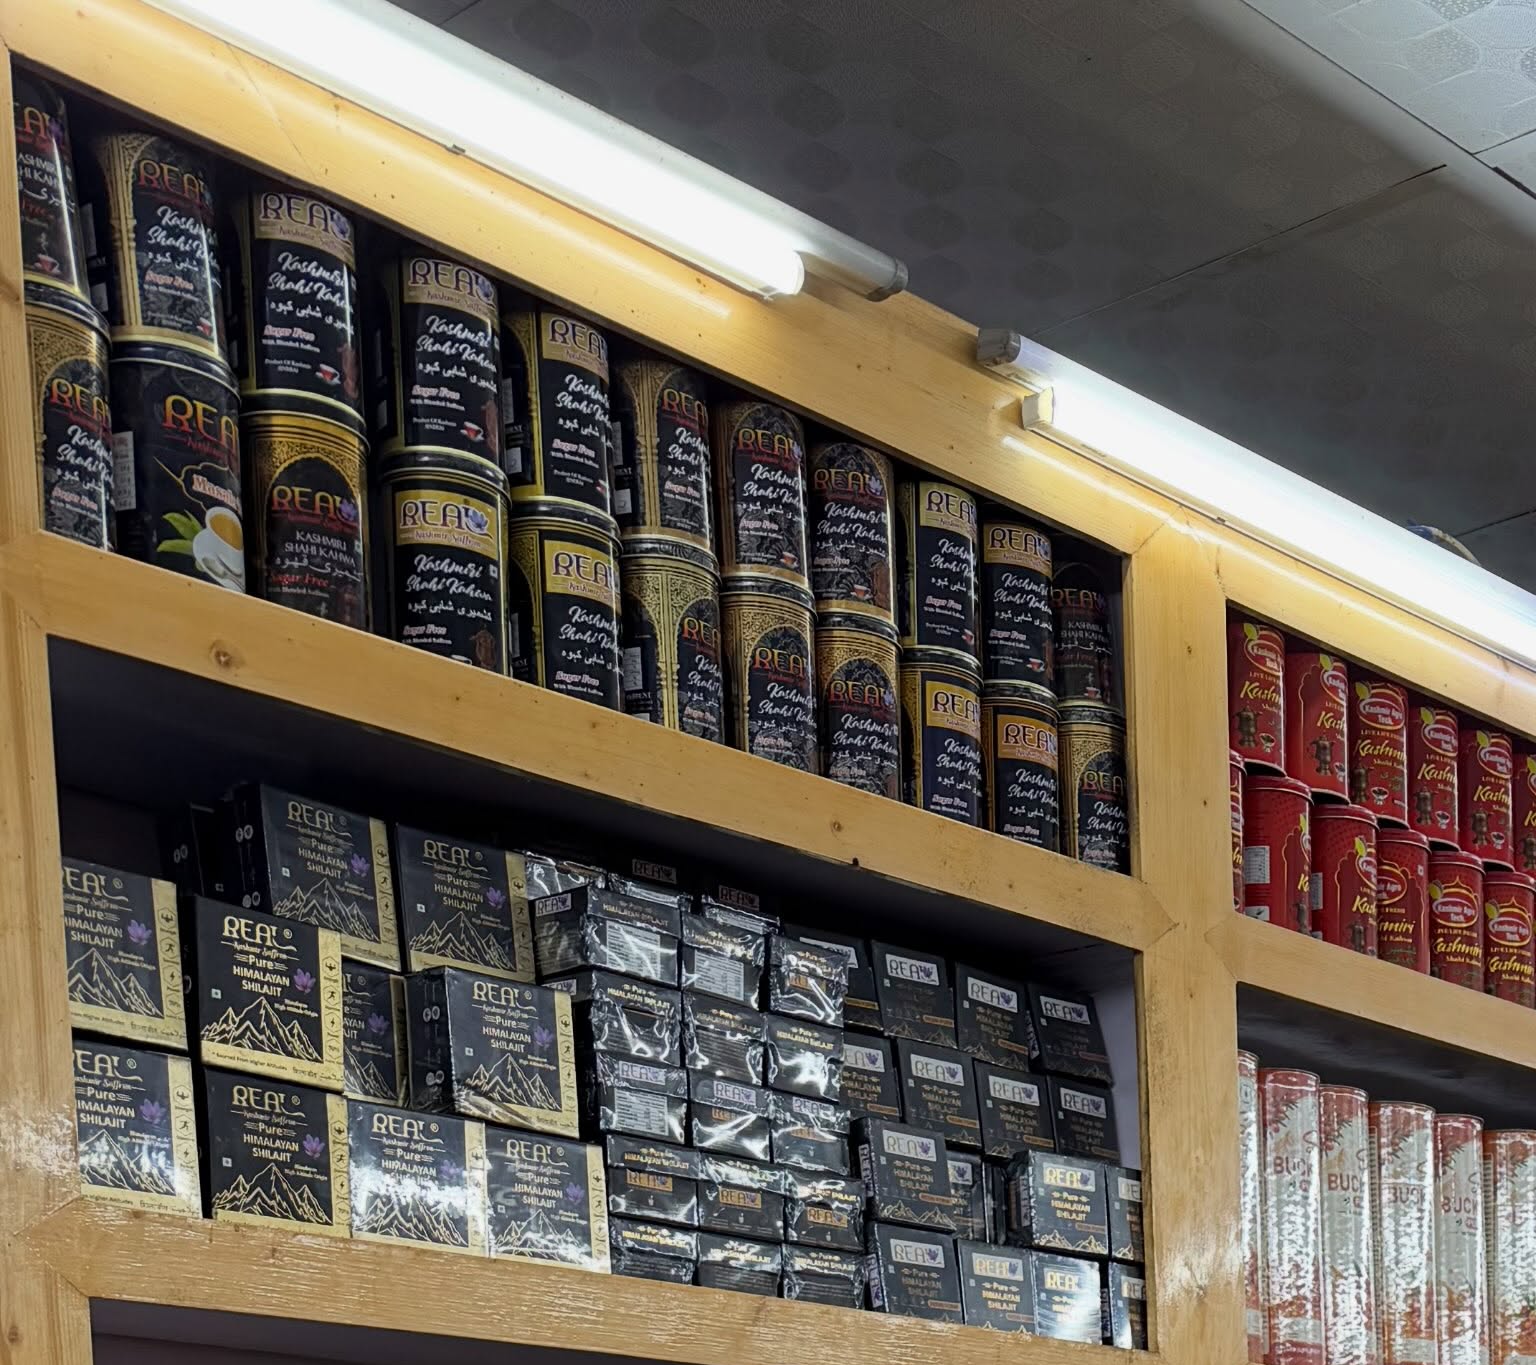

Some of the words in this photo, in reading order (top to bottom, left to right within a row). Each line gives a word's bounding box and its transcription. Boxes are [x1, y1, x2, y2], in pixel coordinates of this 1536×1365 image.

[416, 335, 459, 356] Shahi
[414, 554, 483, 578] Kashmiri
[406, 575, 445, 593] Shahi
[447, 580, 493, 601] Kahwa
[288, 801, 352, 837] REAL
[299, 847, 348, 870] HIMALAYAN
[424, 840, 488, 872] REAL
[307, 862, 342, 879] SHILAJIT
[63, 866, 128, 902] EAL
[434, 883, 484, 903] HIMALAYAN
[77, 904, 104, 920] Pure
[443, 897, 477, 913] SHILAJIT
[71, 931, 115, 948] SHILAJIT
[222, 916, 297, 951] REAL
[248, 954, 274, 969] Pure
[233, 965, 290, 986] HIMALAYAN
[242, 981, 282, 997] SHILAJIT
[473, 981, 537, 1012] REAL
[495, 1015, 517, 1028] Pure
[482, 1026, 532, 1044] HIMALAYAN
[491, 1039, 526, 1053] SHILAJIT
[86, 1088, 117, 1101] Pure
[231, 1085, 305, 1117] REAL
[80, 1113, 126, 1129] SHILAJIT
[258, 1122, 284, 1135] Pure
[372, 1113, 444, 1144] REAL
[243, 1134, 299, 1152] HIMALAYAN
[252, 1147, 292, 1163] SHILAJIT
[396, 1148, 421, 1162] Pure
[506, 1139, 569, 1167] REAL
[381, 1160, 437, 1177] HIMALAYAN
[527, 1172, 550, 1185] Pure
[514, 1183, 563, 1199] HIMALAYAN
[522, 1195, 557, 1209] SHILAJIT
